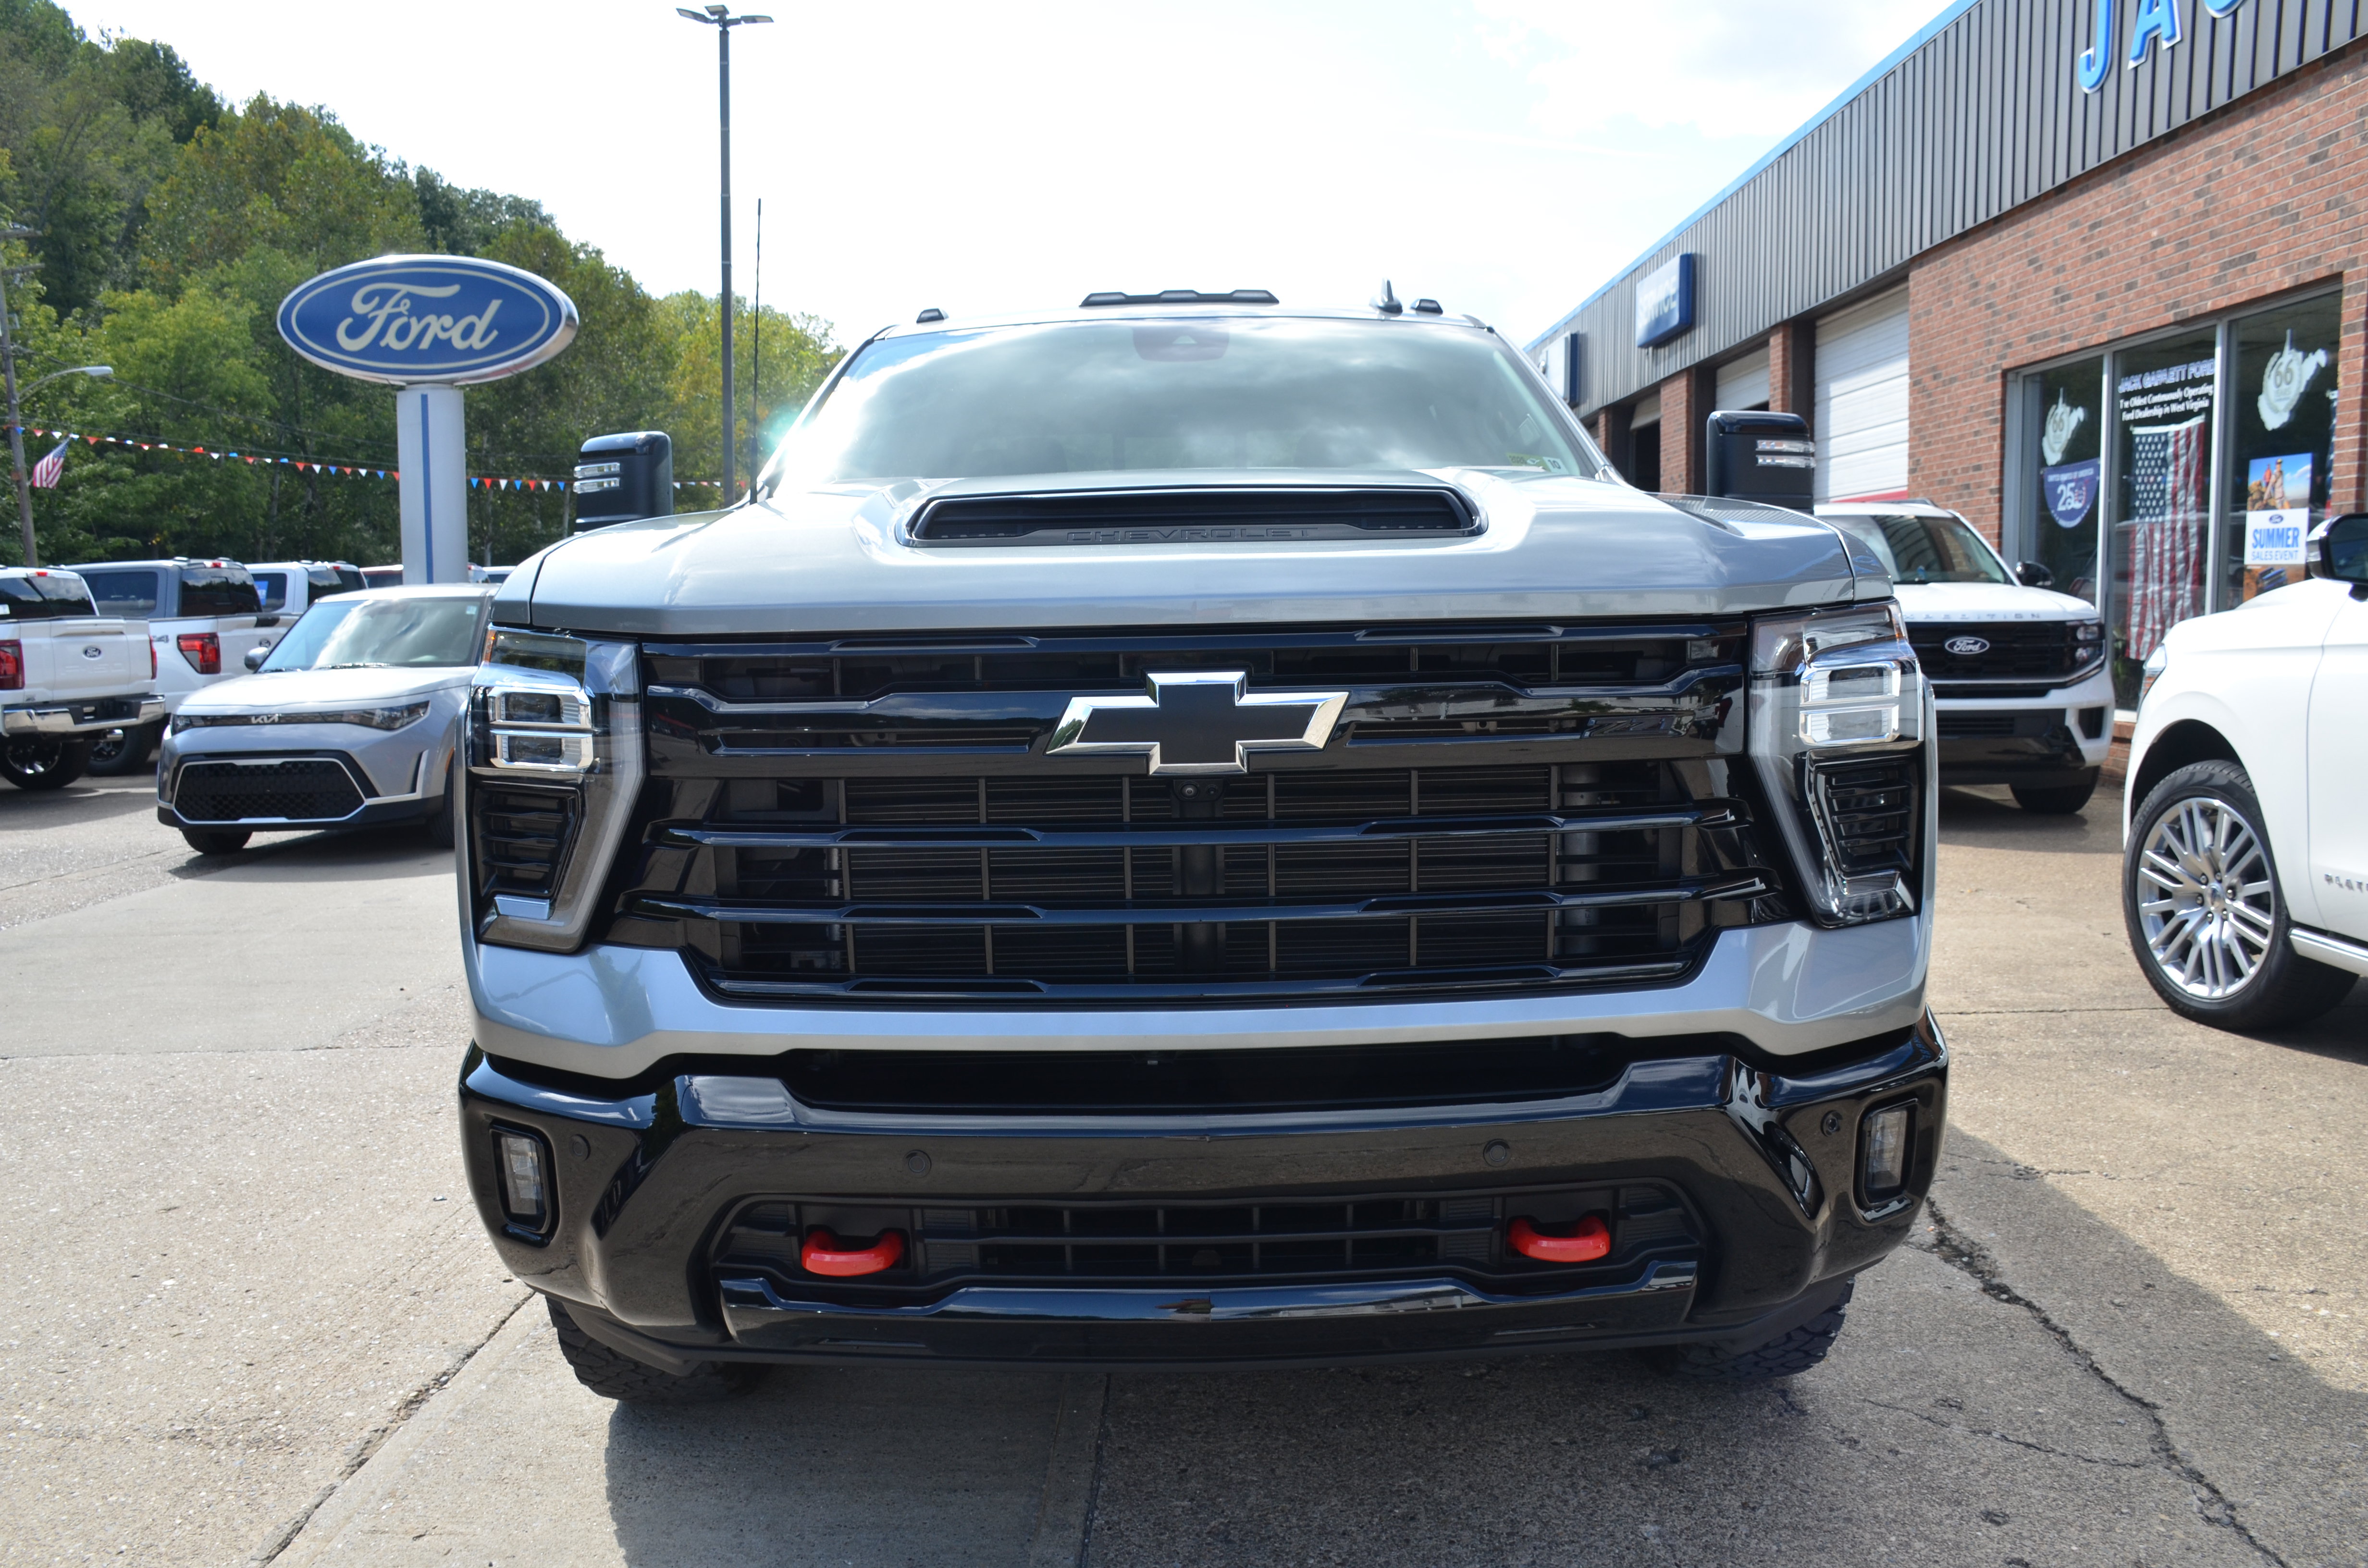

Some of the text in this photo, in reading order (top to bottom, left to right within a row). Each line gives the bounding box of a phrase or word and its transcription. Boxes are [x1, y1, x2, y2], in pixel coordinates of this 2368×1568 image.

[2078, 0, 2250, 94] JA
[336, 282, 503, 352] Ford
[2118, 357, 2215, 393] JACK GARRETT FORD
[2183, 382, 2214, 399] Operating
[2122, 396, 2209, 421] Ford Dealership in West Virginia
[1067, 527, 1318, 541] CHEVROLET
[2252, 527, 2300, 549] SUMMER
[2251, 550, 2299, 561] SALES EVENT
[1953, 639, 1981, 652] Ford
[2324, 873, 2368, 893] PLAT
